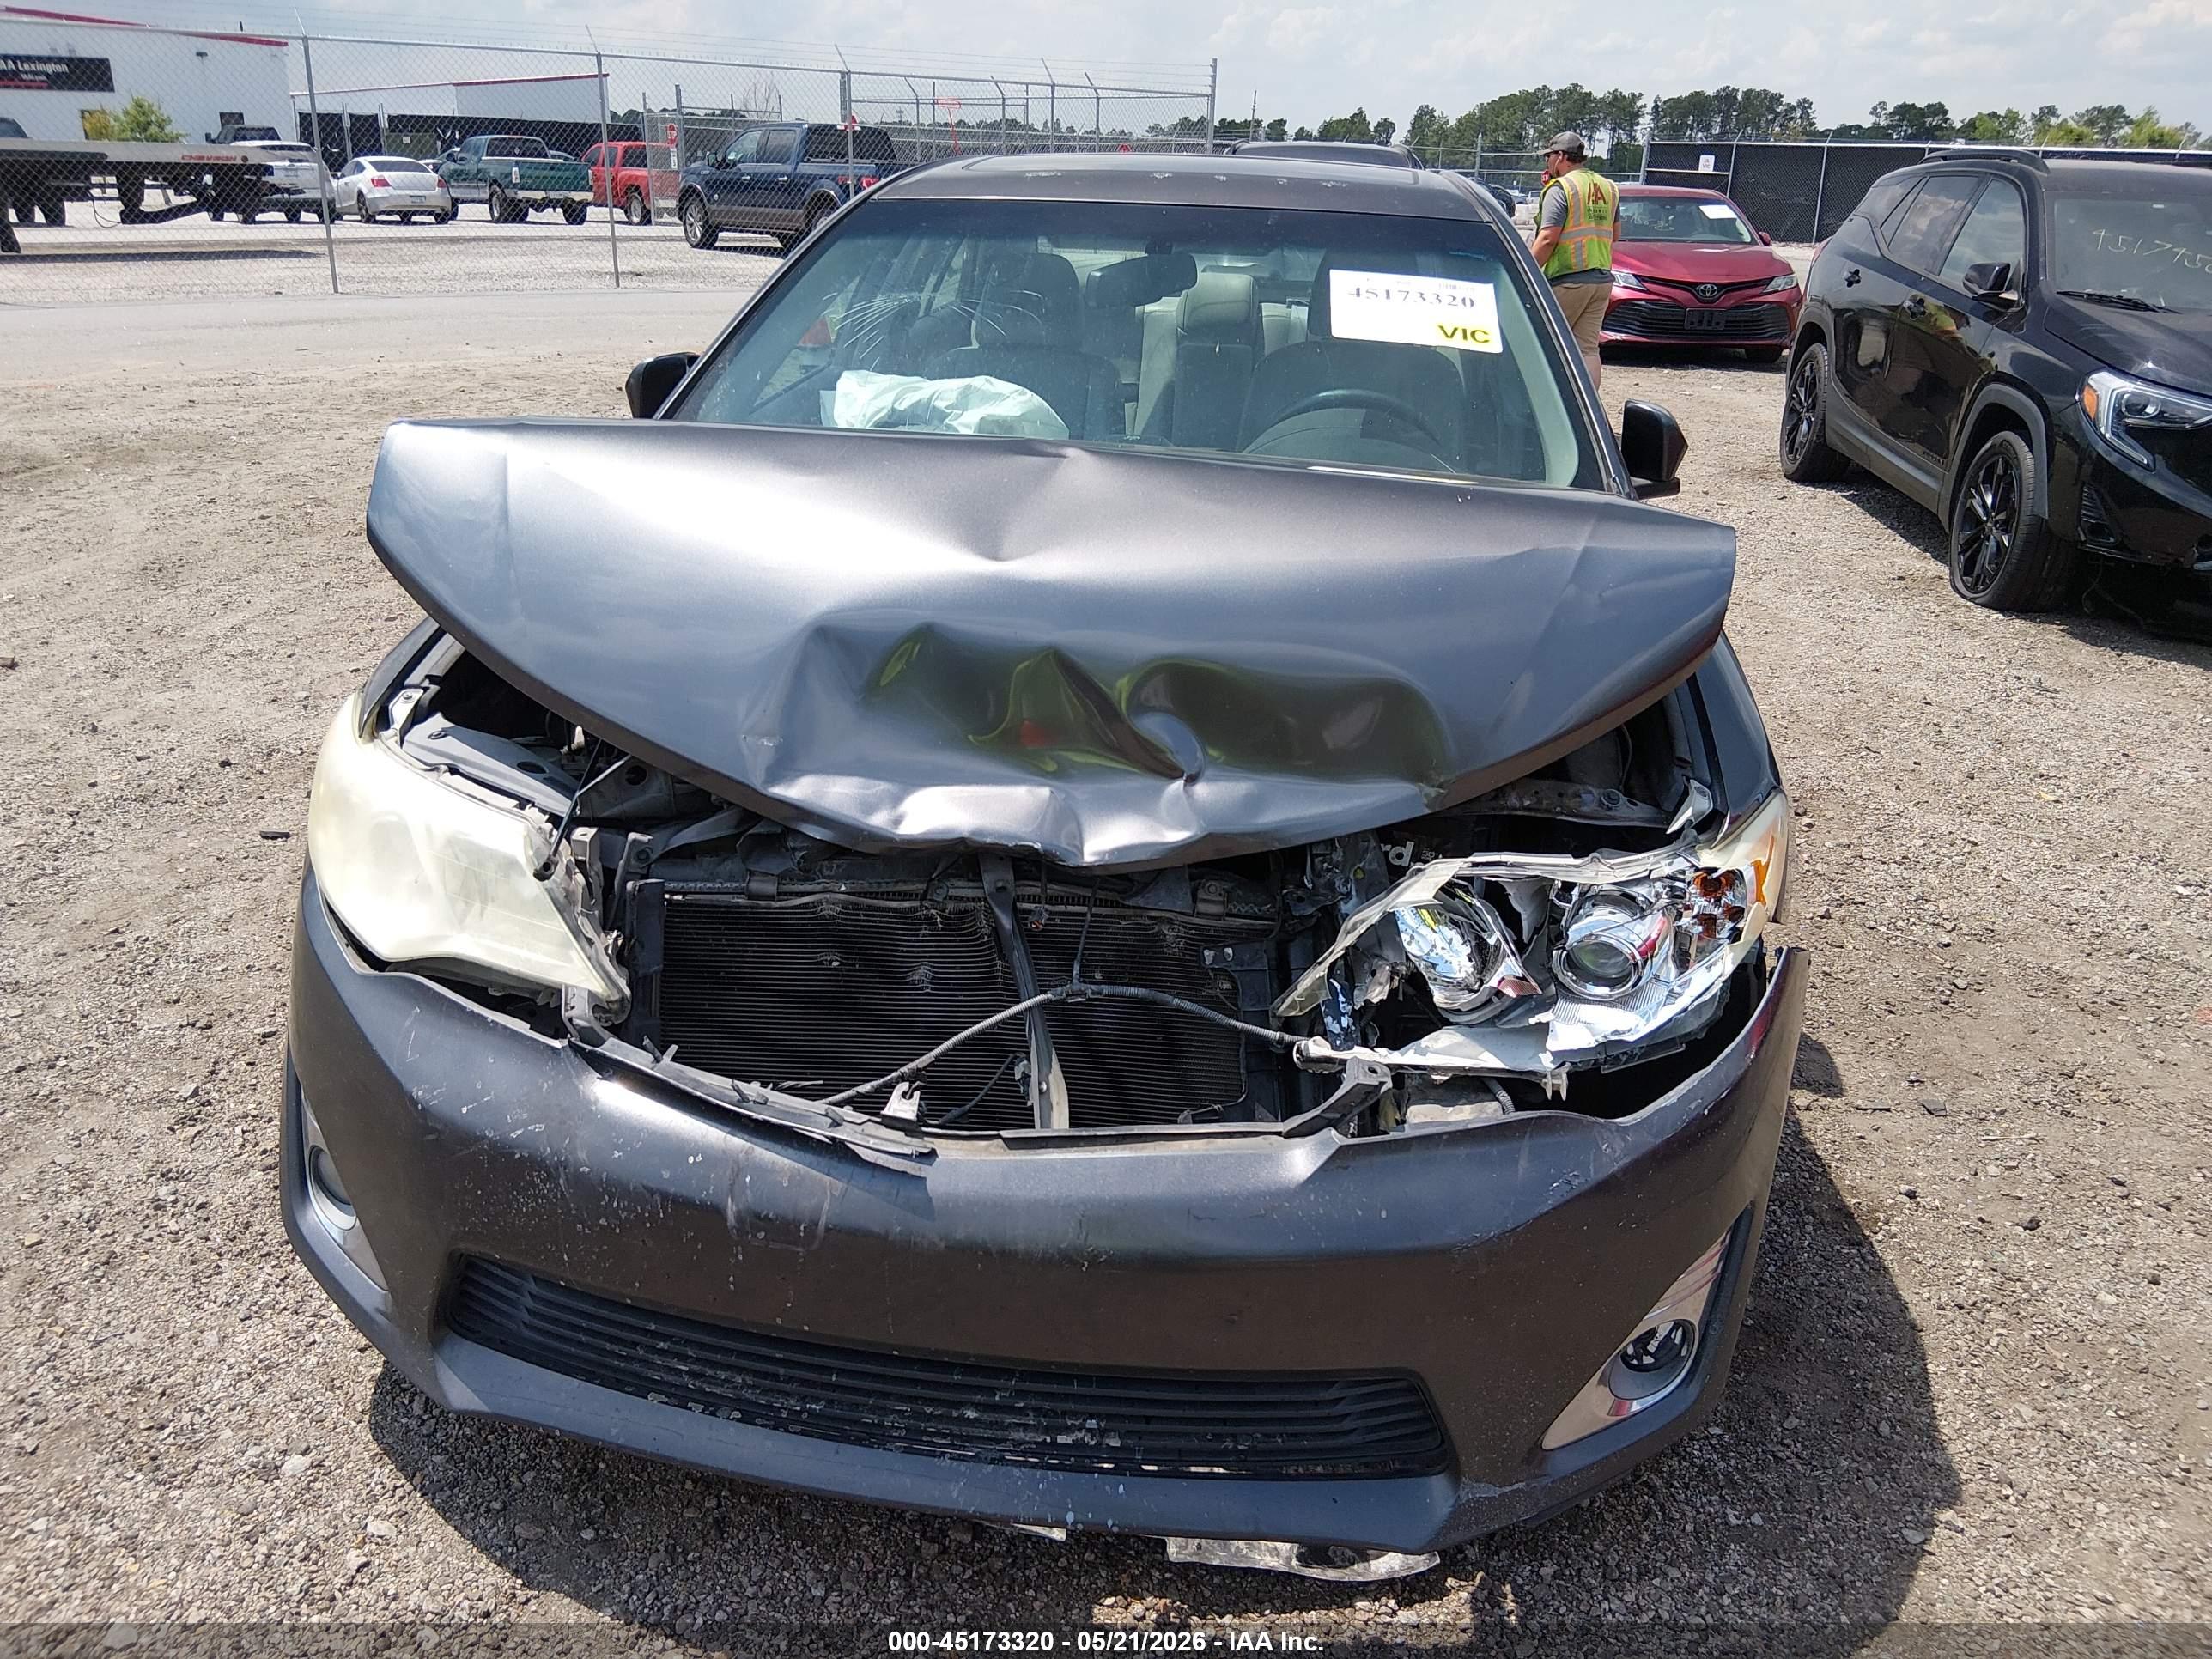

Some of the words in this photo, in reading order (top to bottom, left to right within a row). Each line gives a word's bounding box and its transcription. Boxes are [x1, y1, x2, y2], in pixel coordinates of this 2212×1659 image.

[17, 60, 69, 75] Lexington
[1348, 286, 1475, 308] 45173320
[1437, 324, 1491, 343] VIC
